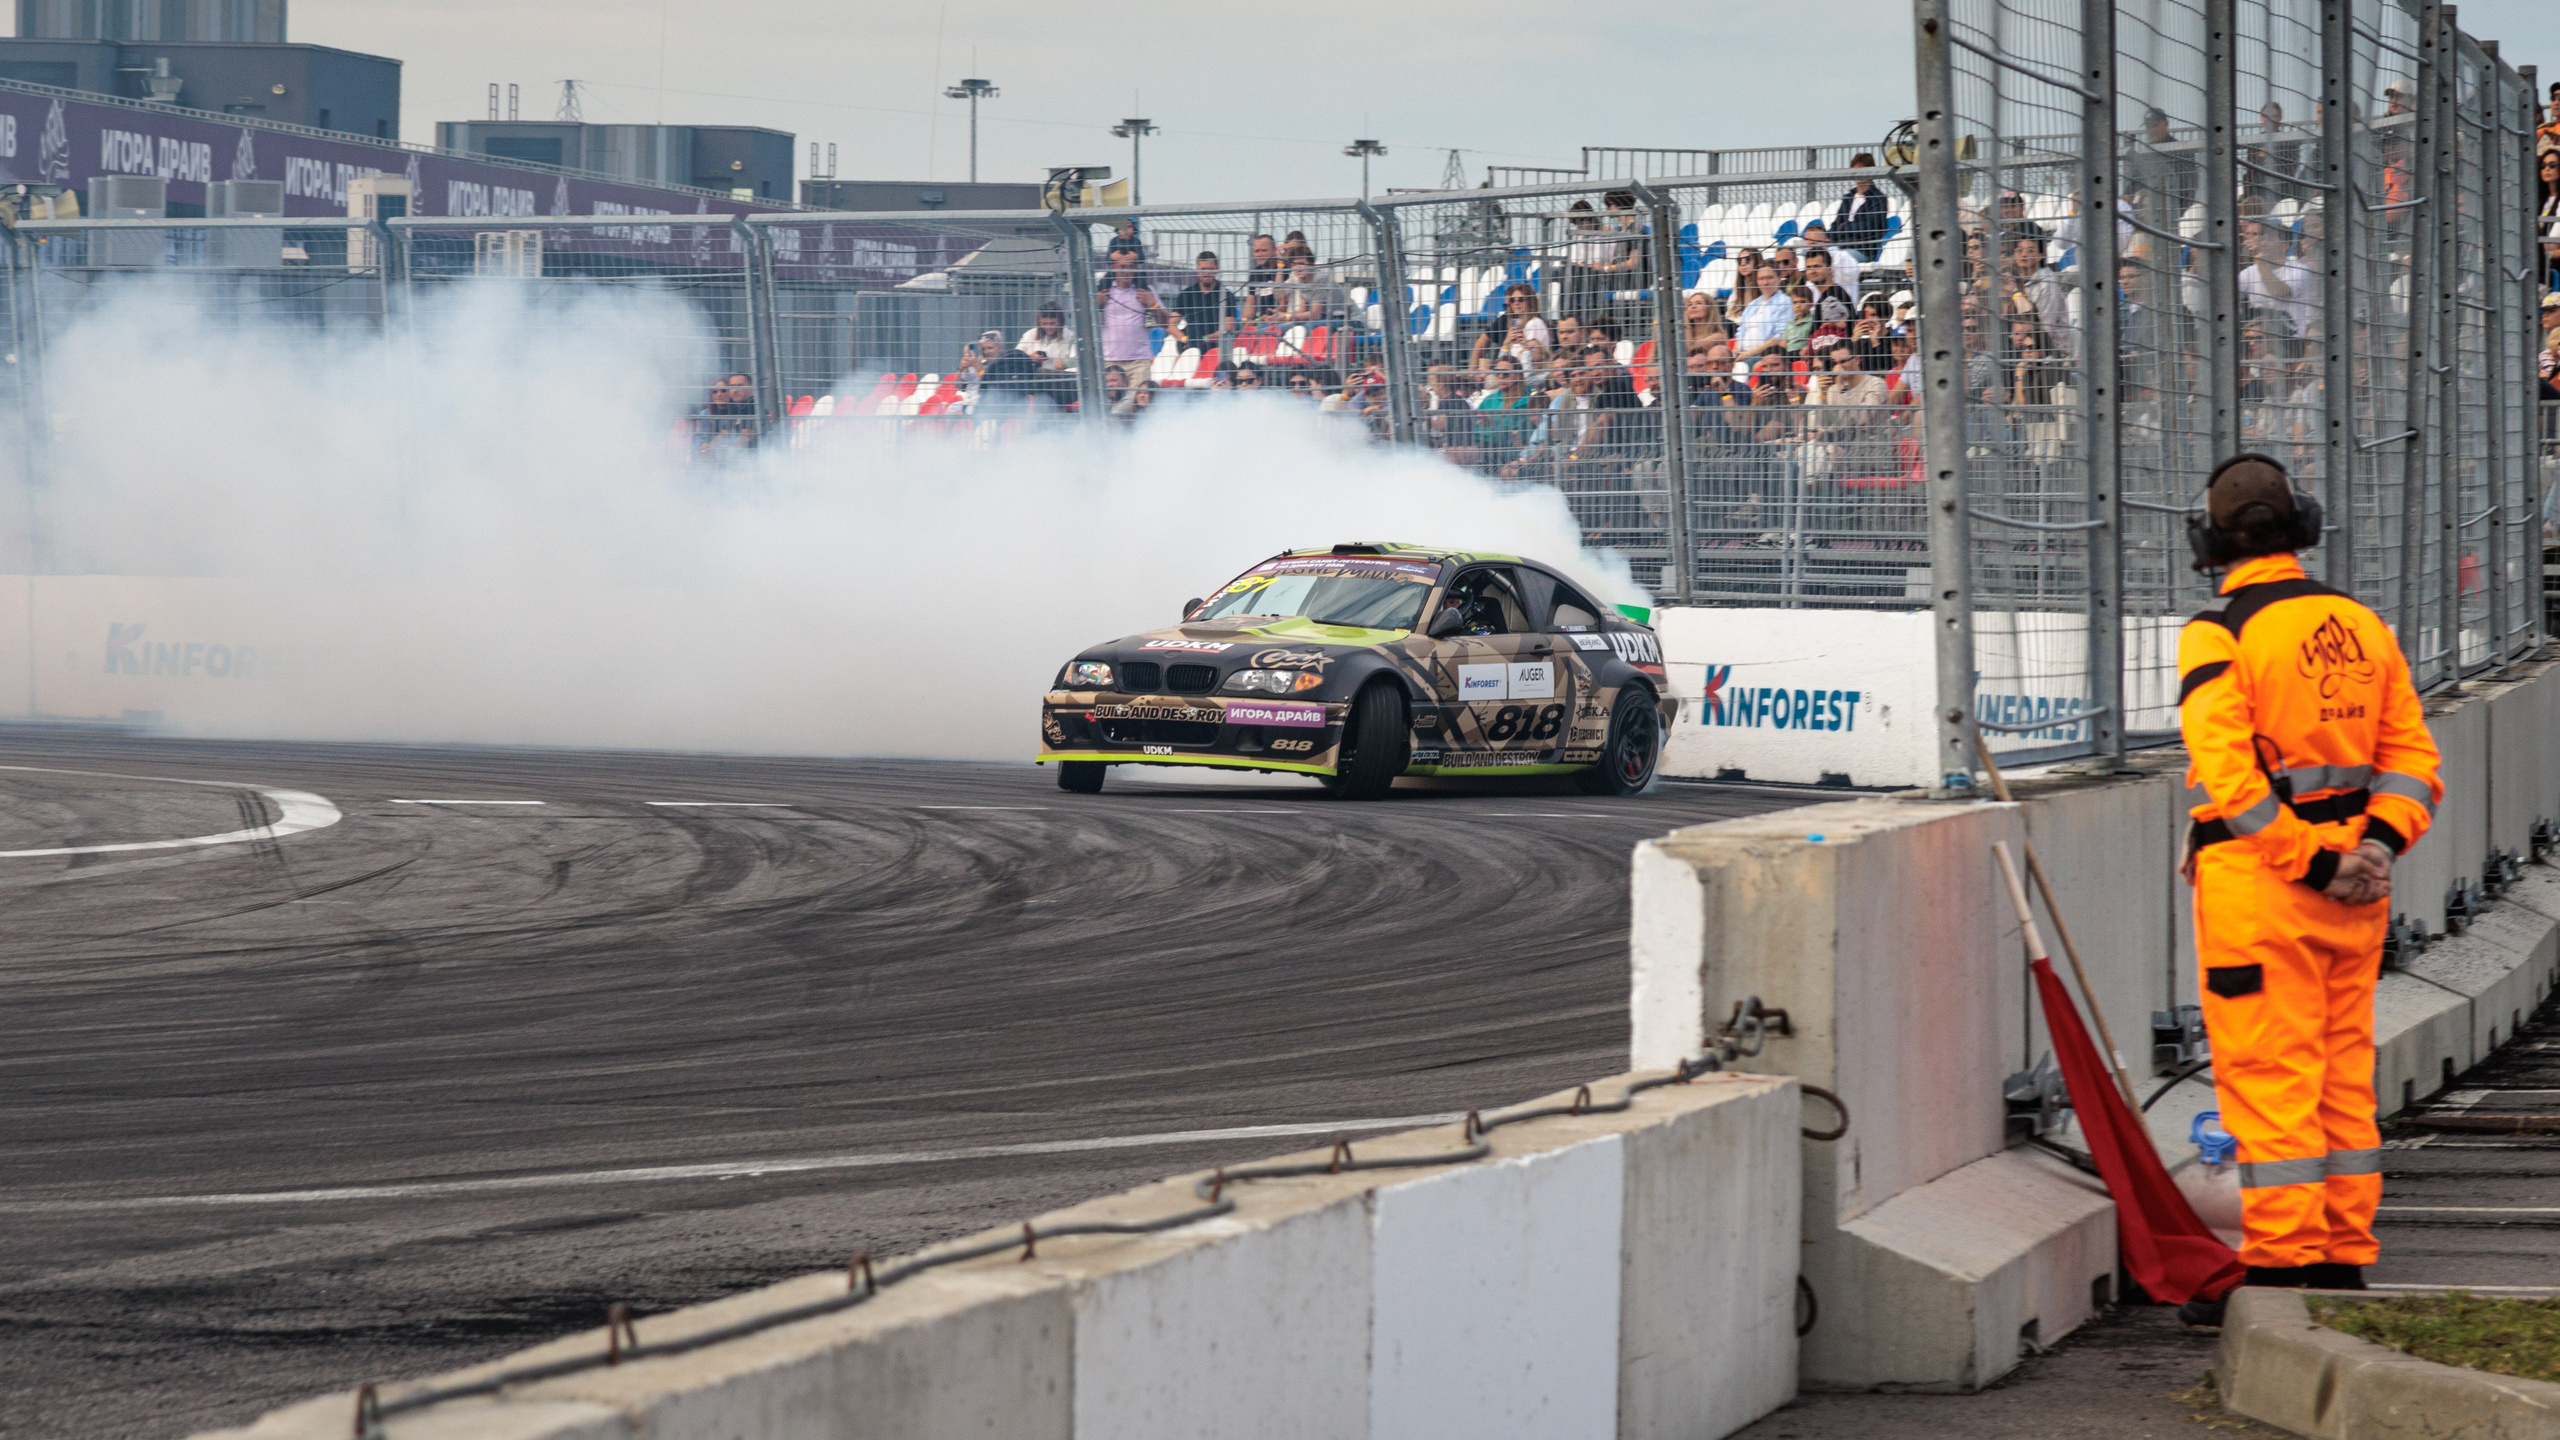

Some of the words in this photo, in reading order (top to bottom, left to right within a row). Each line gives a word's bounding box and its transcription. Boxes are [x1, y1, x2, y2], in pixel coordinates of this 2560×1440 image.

[102, 129, 154, 176] ИГОРА
[286, 156, 333, 200] ИГОРА
[1145, 640, 1235, 651] UDKM
[1608, 633, 1662, 664] UDKM
[1519, 668, 1545, 682] AUGER
[1464, 677, 1499, 689] KINFOREST
[1702, 664, 1861, 732] KINFOREST
[1131, 706, 1160, 721] AND
[1230, 709, 1273, 720] ИГОРА
[1275, 710, 1322, 722] ДРАЙВ
[1488, 703, 1566, 741] 818
[1143, 745, 1173, 755] UDKM
[1271, 739, 1314, 751] 818
[1443, 752, 1472, 768] BUILD
[1473, 751, 1495, 767] AND
[1495, 750, 1540, 766] DESTROY
